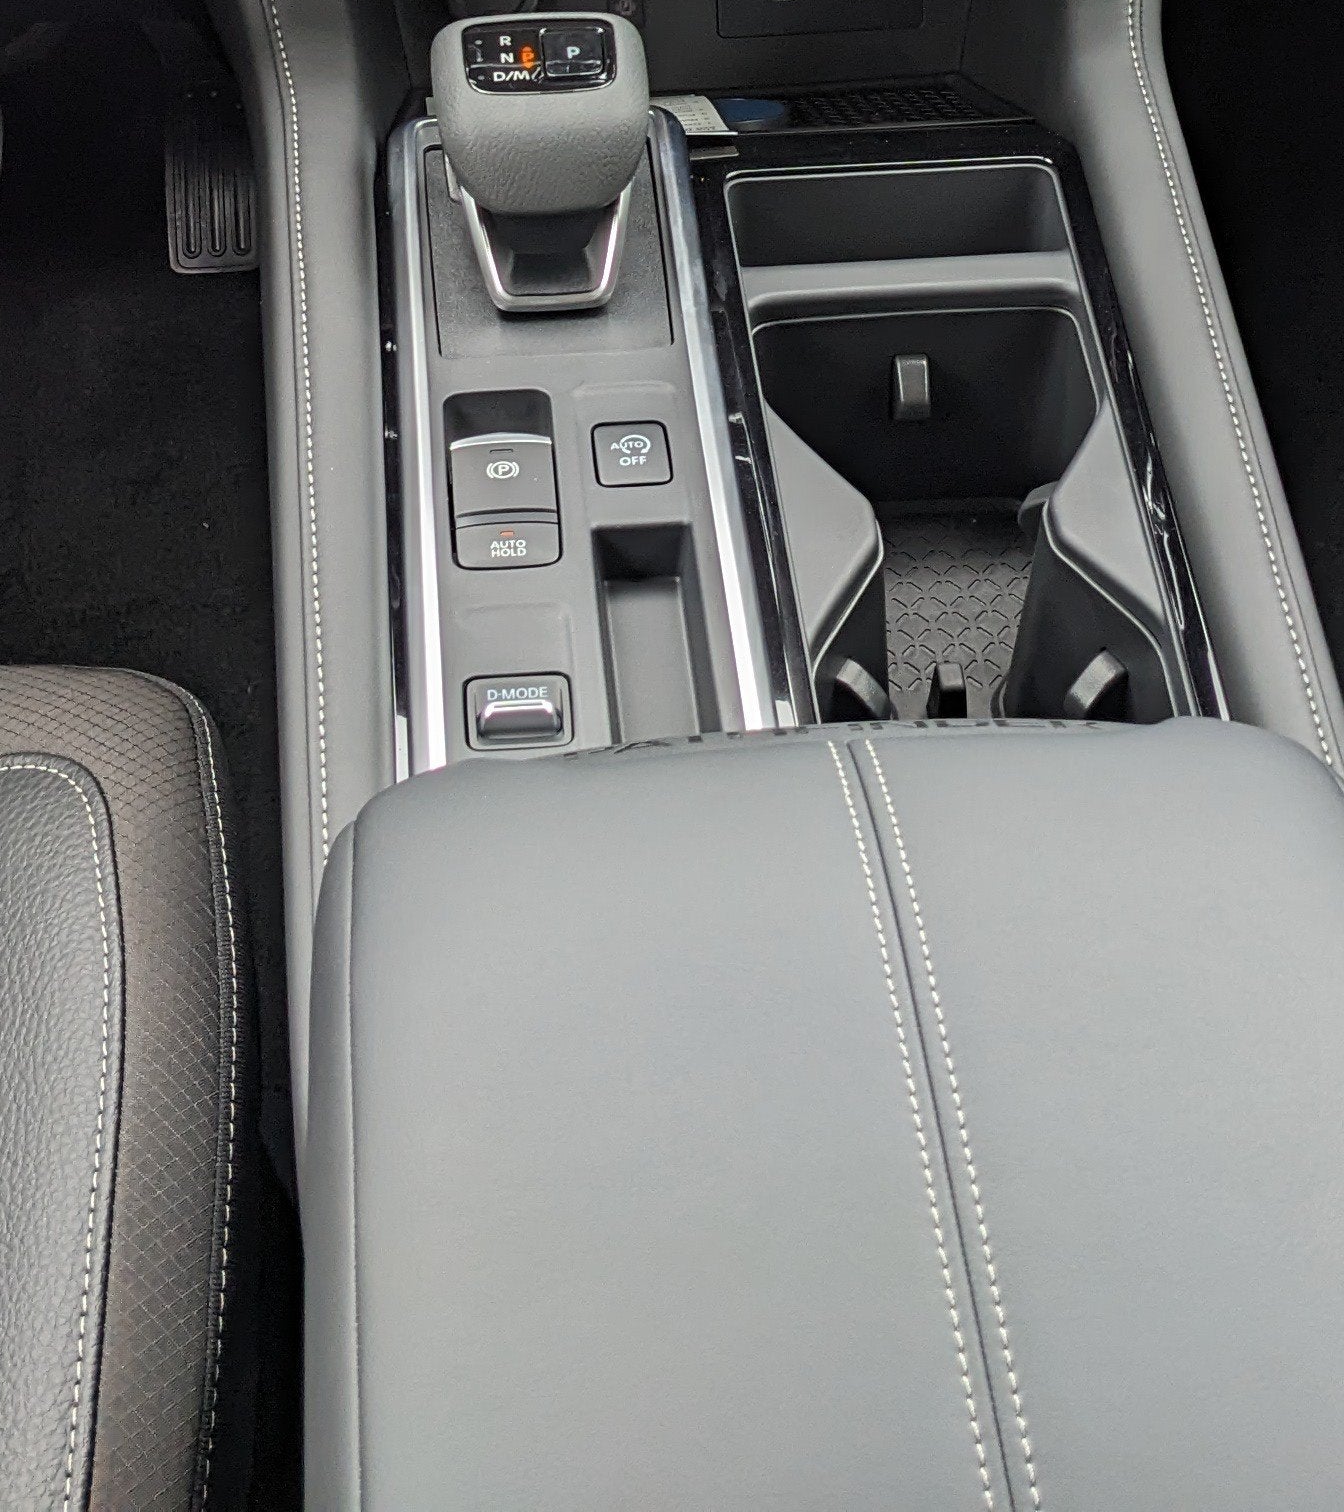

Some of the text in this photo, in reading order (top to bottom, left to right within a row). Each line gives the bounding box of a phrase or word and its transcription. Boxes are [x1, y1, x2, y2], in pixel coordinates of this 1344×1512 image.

[498, 35, 512, 47] R
[500, 52, 515, 64] N
[566, 46, 581, 59] P
[493, 70, 531, 83] D/M
[609, 440, 644, 451] AUTO
[619, 455, 647, 466] OFF
[490, 538, 527, 549] AUTO
[491, 547, 527, 558] HOLD
[486, 686, 548, 701] D-MODE
